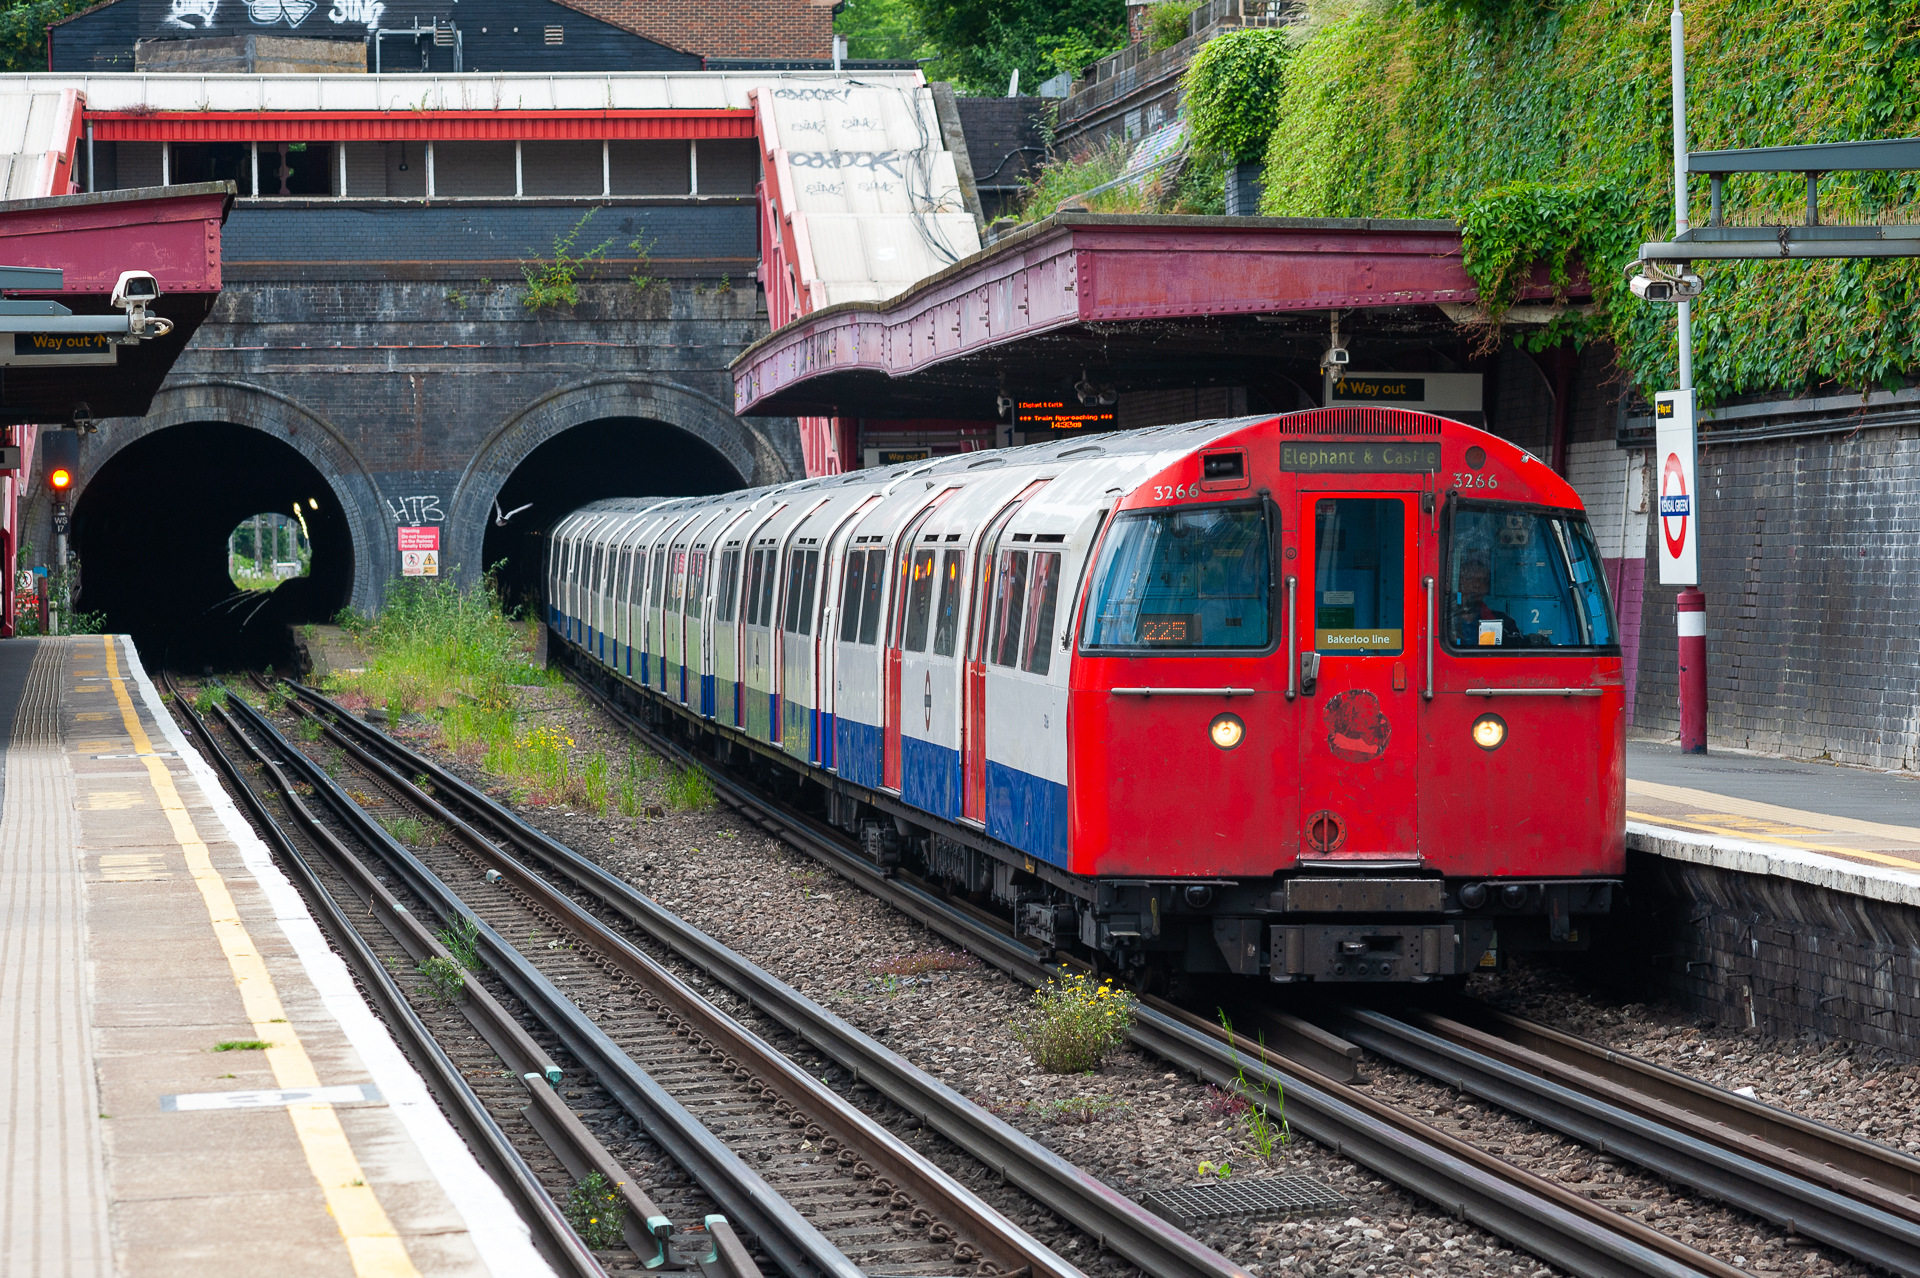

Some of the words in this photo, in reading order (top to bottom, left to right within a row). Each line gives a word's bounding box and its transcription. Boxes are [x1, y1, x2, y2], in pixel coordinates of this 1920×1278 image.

[33, 336, 62, 350] Way
[66, 336, 91, 347] out
[1350, 382, 1379, 397] Way
[1382, 383, 1406, 395] out
[1055, 413, 1098, 421] Approaching
[888, 453, 904, 461] Way
[1283, 448, 1355, 468] Elephant
[1363, 449, 1374, 464] &
[1383, 448, 1435, 464] Castle
[1453, 472, 1498, 489] 3266
[1153, 483, 1199, 501] 3266
[1661, 499, 1675, 512] KENSAL
[1675, 499, 1689, 512] GREEN
[1143, 621, 1186, 640] 225
[1327, 634, 1369, 644] Bakerloo
[1372, 634, 1390, 644] line
